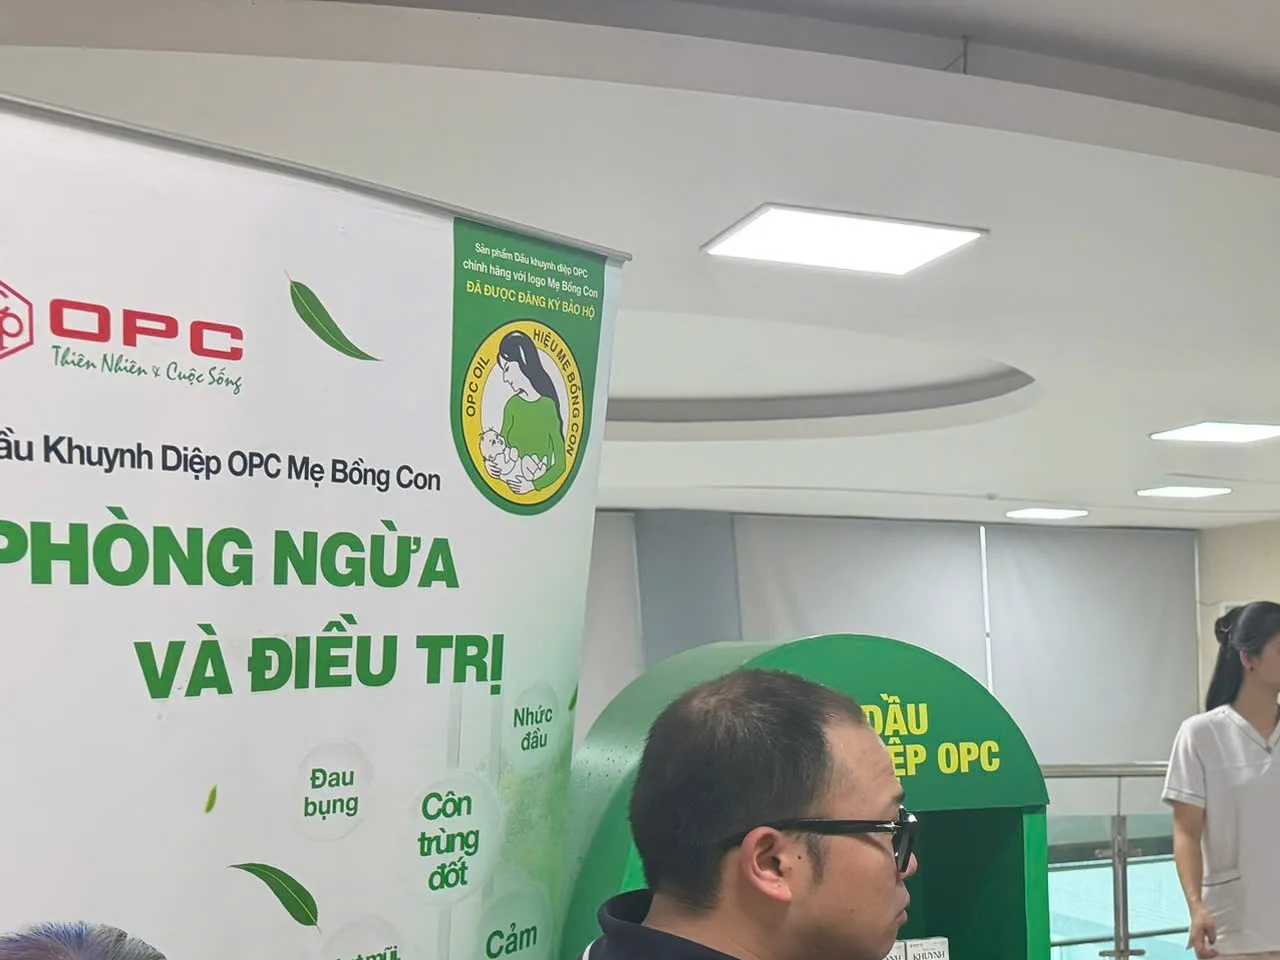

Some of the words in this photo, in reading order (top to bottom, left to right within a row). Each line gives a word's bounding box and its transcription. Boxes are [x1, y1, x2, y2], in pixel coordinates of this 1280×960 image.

[463, 260, 488, 273] chính
[490, 266, 511, 280] hãng
[513, 272, 526, 282] với
[528, 273, 546, 287] logo
[547, 278, 560, 292] Mẹ
[583, 286, 598, 299] Con
[530, 256, 556, 271] khuynh
[573, 267, 588, 279] OPC
[467, 280, 482, 295] ĐÃ
[484, 284, 516, 302] ĐƯỢC
[548, 297, 561, 311] KÝ
[582, 305, 595, 320] HỘ
[50, 298, 243, 361] OPC
[51, 345, 97, 370] Thiên
[101, 353, 148, 376] Nhiên
[152, 366, 161, 378] &
[166, 361, 204, 386] Cuộc
[208, 367, 242, 395] Sống
[466, 381, 479, 417] OPC
[473, 356, 490, 379] OIL
[533, 328, 558, 352] HIỆU
[556, 348, 571, 372] MẸ
[566, 425, 579, 456] CON
[0, 430, 34, 463] ầu
[44, 435, 154, 473] Khuynh
[161, 443, 222, 481] Diệp
[228, 450, 281, 478] OPC
[287, 457, 325, 488] Mẹ
[331, 457, 390, 492] Bồng
[396, 465, 441, 490] Con
[0, 505, 254, 587] PHÒNG
[274, 519, 459, 589] NGỪA
[134, 623, 234, 699] VÀ
[248, 613, 399, 693] ĐIỀU
[416, 633, 505, 696] TRỊ
[513, 706, 553, 728] Nhức
[861, 693, 929, 737] DẦU
[520, 727, 547, 751] đầu
[310, 768, 354, 789] Đau
[887, 737, 927, 783] ỆP
[938, 740, 1000, 774] OPC
[304, 795, 359, 820] bụng
[422, 790, 472, 820] Côn
[417, 828, 479, 856] trùng
[428, 856, 468, 890] đốt
[485, 922, 537, 959] Cảm
